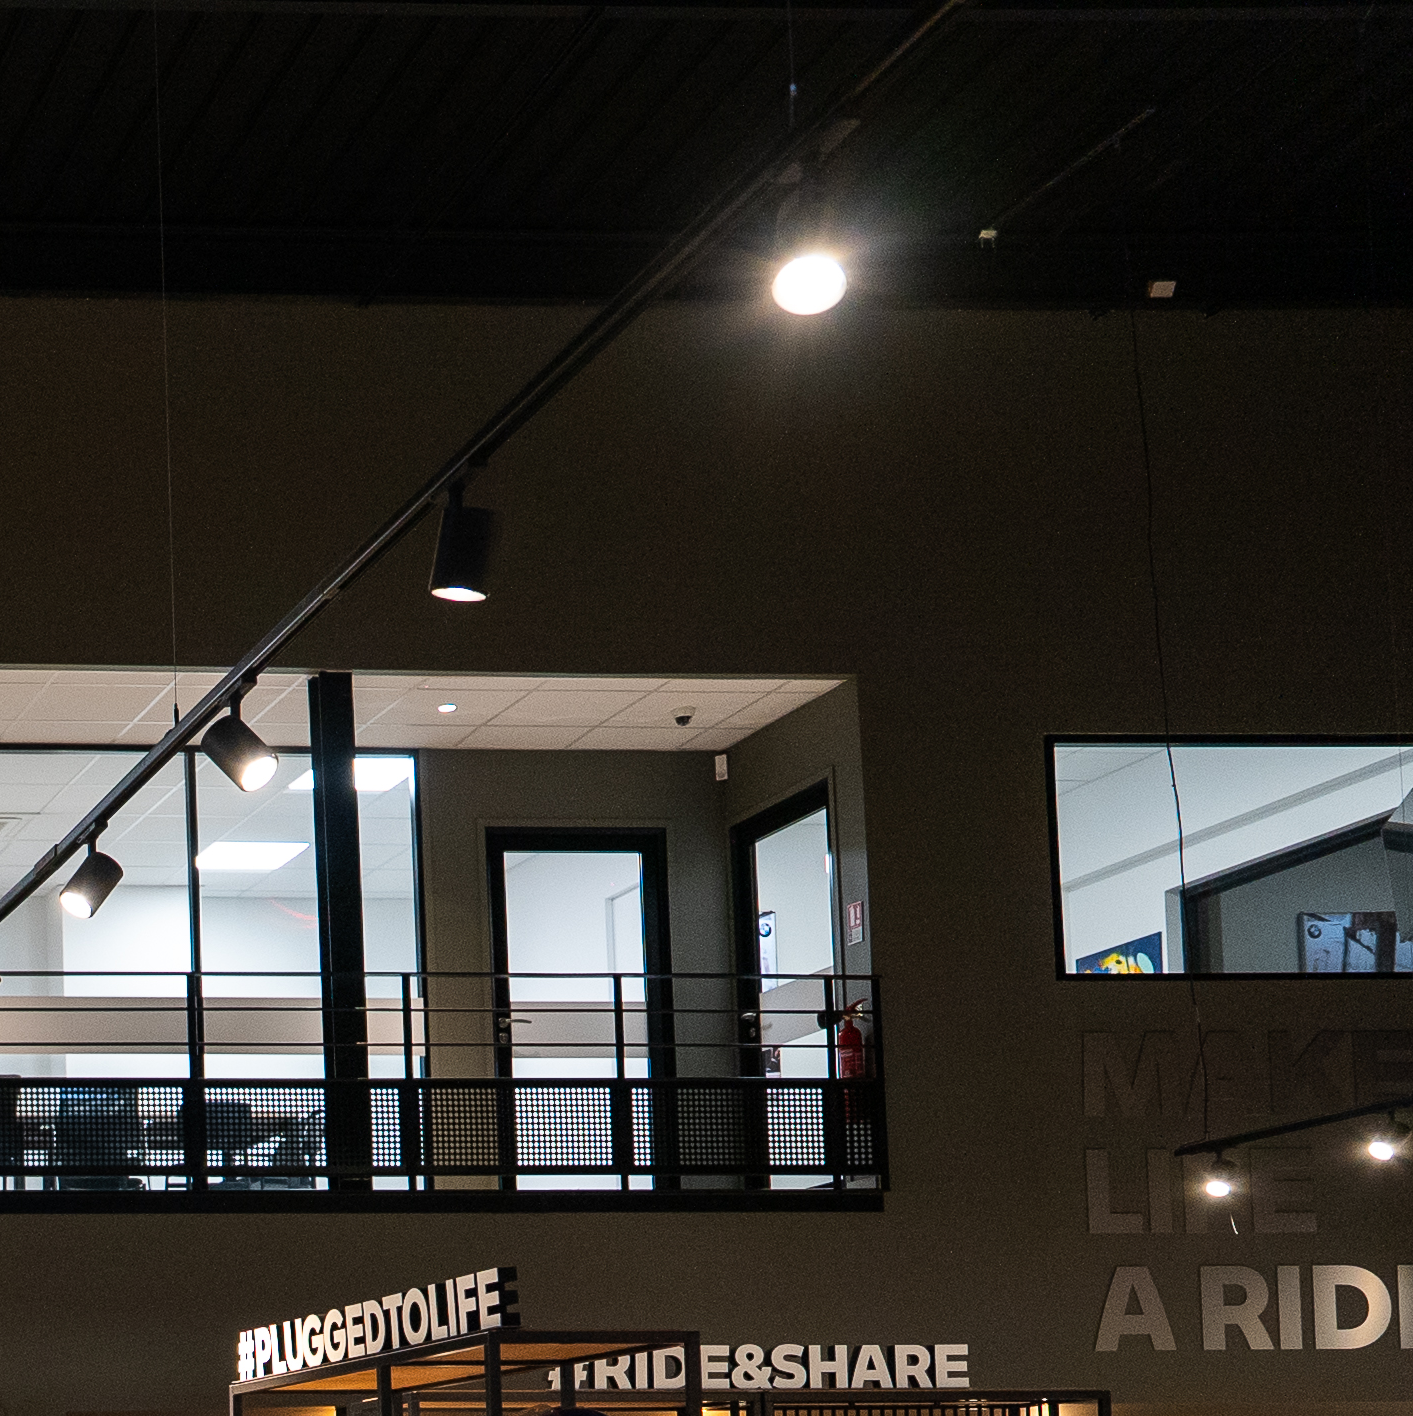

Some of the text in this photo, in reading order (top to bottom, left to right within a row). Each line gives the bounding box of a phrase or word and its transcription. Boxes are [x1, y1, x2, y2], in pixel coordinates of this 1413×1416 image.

[237, 1267, 503, 1381] #PLUGGEDTOLIFE
[1094, 1265, 1413, 1352] A RID
